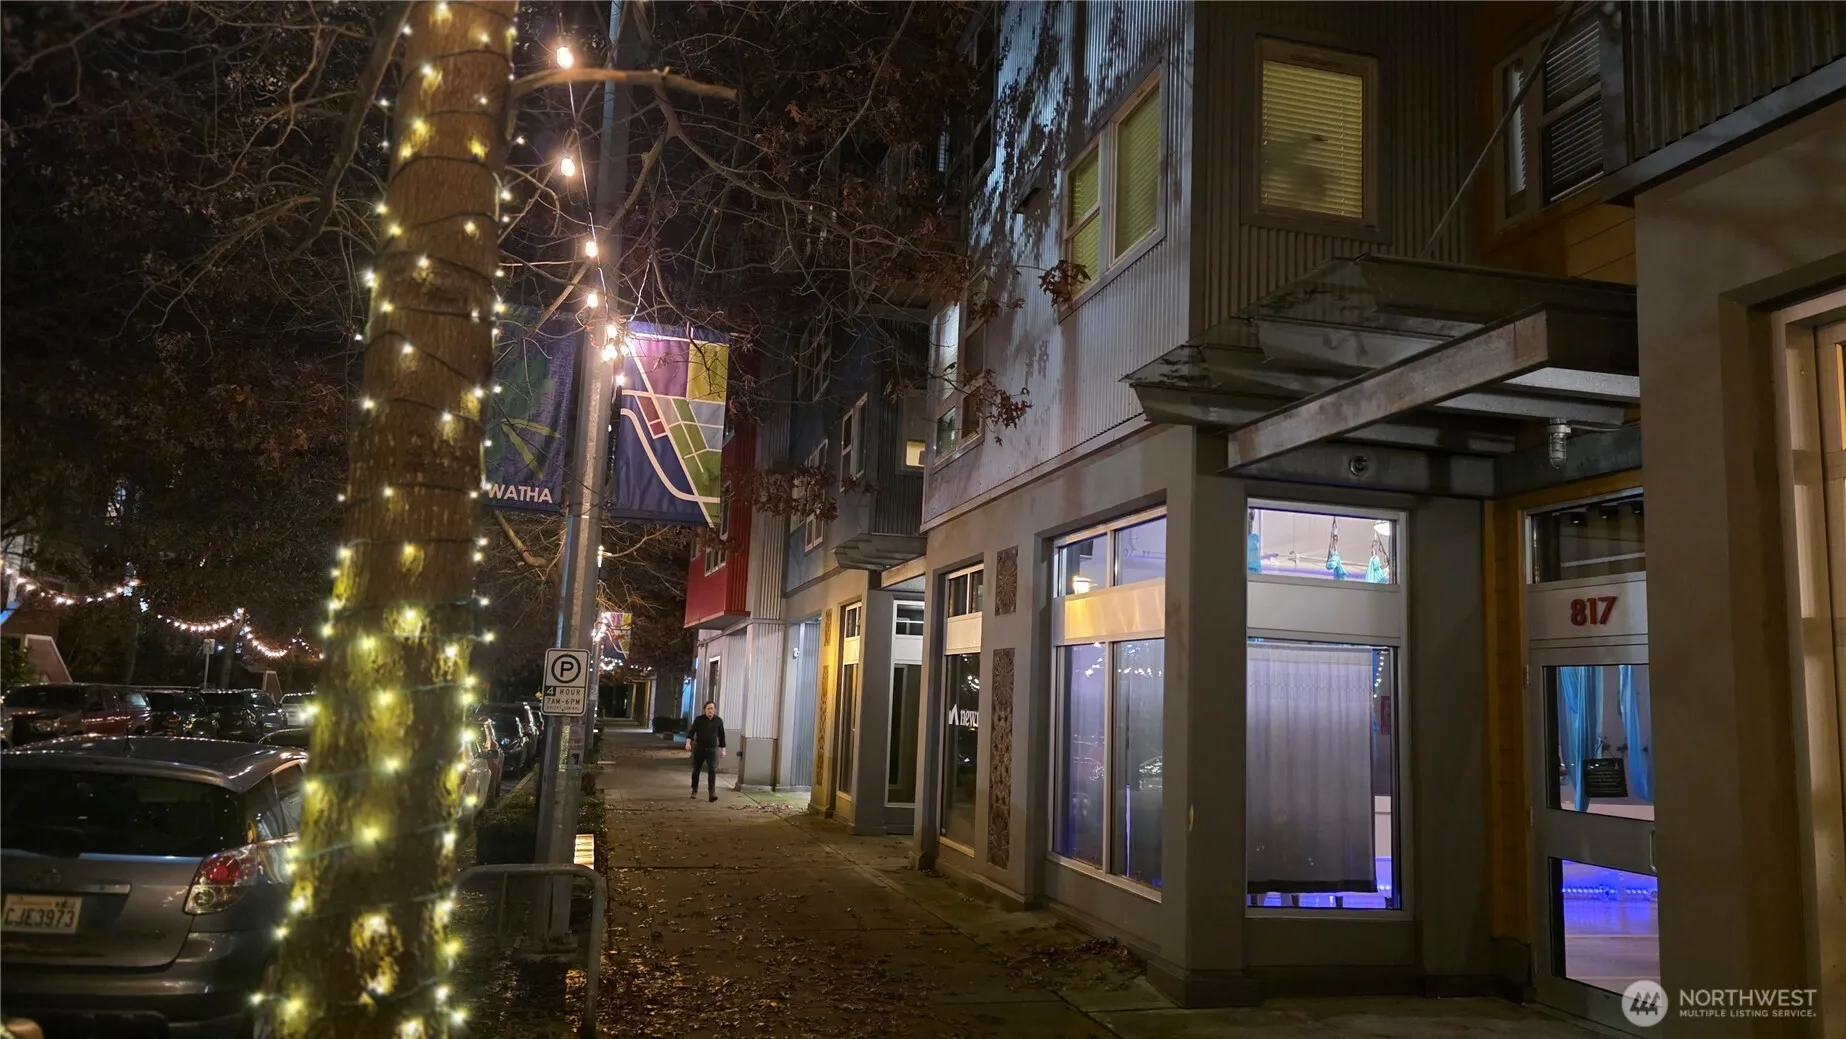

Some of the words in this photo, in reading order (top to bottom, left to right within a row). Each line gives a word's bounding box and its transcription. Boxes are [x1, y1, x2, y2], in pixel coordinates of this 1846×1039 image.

[1570, 595, 1618, 626] 817
[560, 661, 574, 677] P
[546, 687, 554, 695] 4
[559, 688, 581, 696] HOUR
[546, 697, 581, 706] 7AM-6PM
[4, 907, 76, 928] CJE3973
